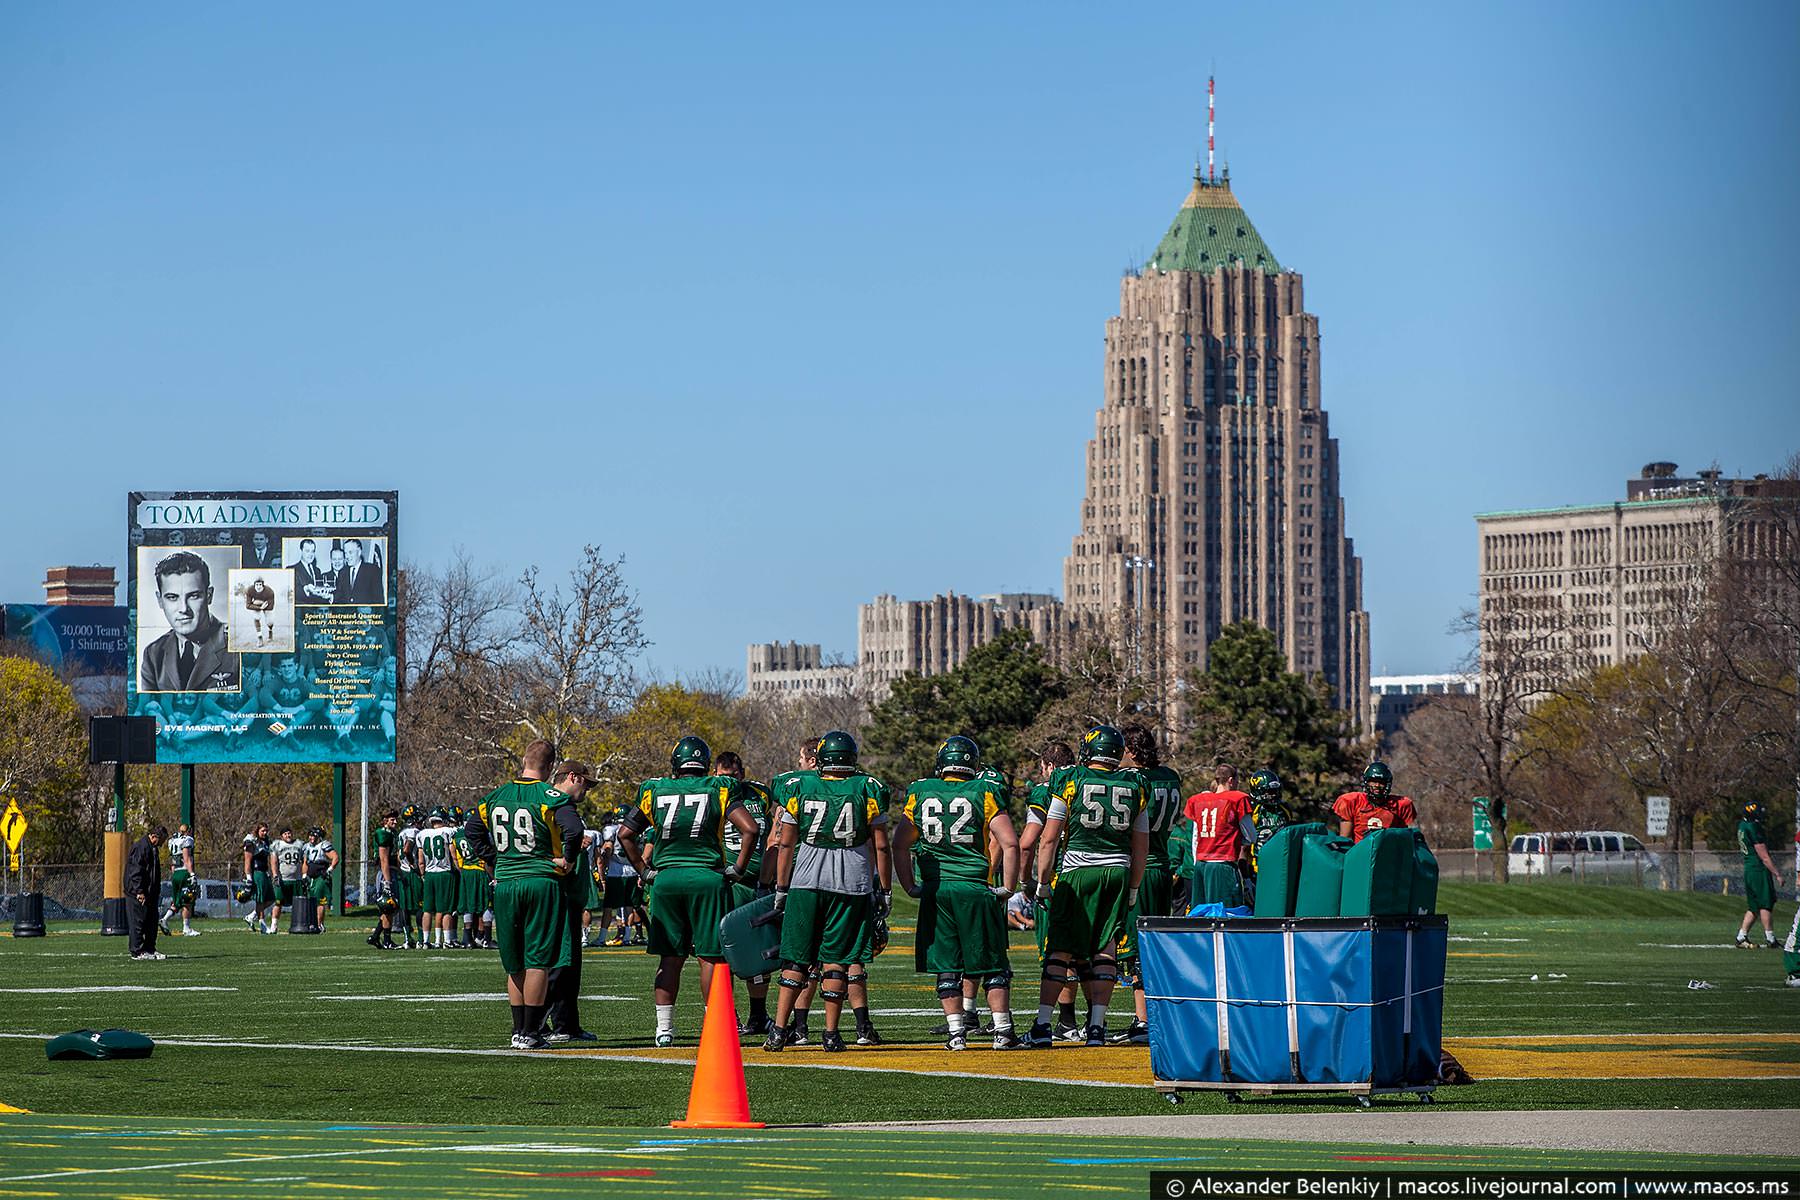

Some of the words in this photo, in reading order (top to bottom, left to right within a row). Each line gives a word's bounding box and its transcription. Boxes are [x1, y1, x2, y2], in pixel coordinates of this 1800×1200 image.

[146, 505, 205, 524] TOM
[212, 505, 300, 524] ADAMS
[307, 504, 381, 524] FIELD
[358, 612, 382, 620] Quarter
[60, 624, 93, 637] 30,000
[94, 624, 121, 637] Team
[343, 628, 366, 636] Scoring
[78, 638, 115, 654] Shining
[324, 660, 344, 668] Flying
[326, 652, 341, 660] Navy
[342, 651, 360, 659] Cross
[341, 692, 376, 701] Community
[656, 793, 709, 840] 77
[1079, 784, 1132, 832] 55
[491, 806, 537, 853] 69
[803, 800, 857, 847] 74
[921, 797, 974, 844] 62
[1200, 807, 1219, 838] 11
[423, 834, 446, 861] 48
[284, 852, 300, 865] 99
